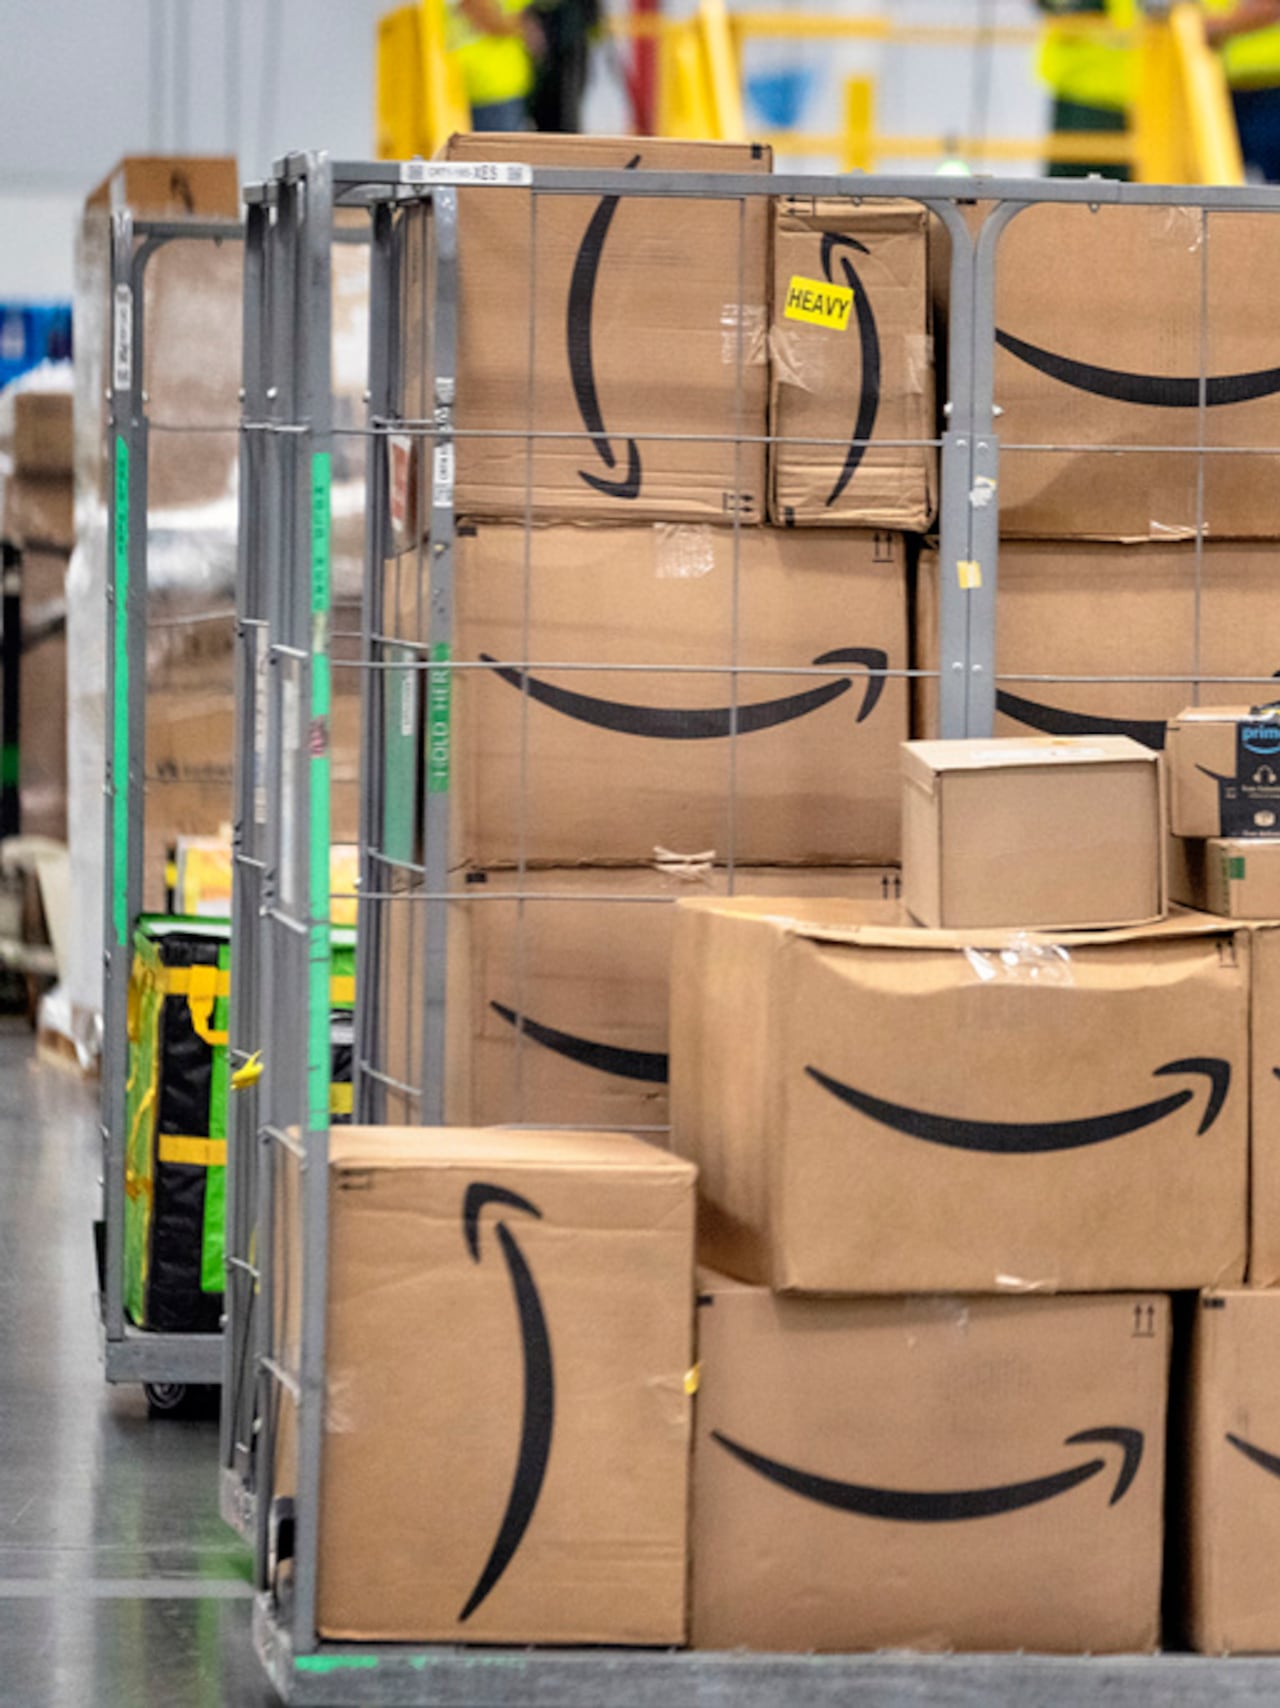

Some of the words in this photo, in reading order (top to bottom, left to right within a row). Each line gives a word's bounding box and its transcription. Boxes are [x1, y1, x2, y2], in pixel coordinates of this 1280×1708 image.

[787, 287, 849, 319] HEAVY
[431, 661, 450, 711] HER
[431, 721, 449, 777] HOLD
